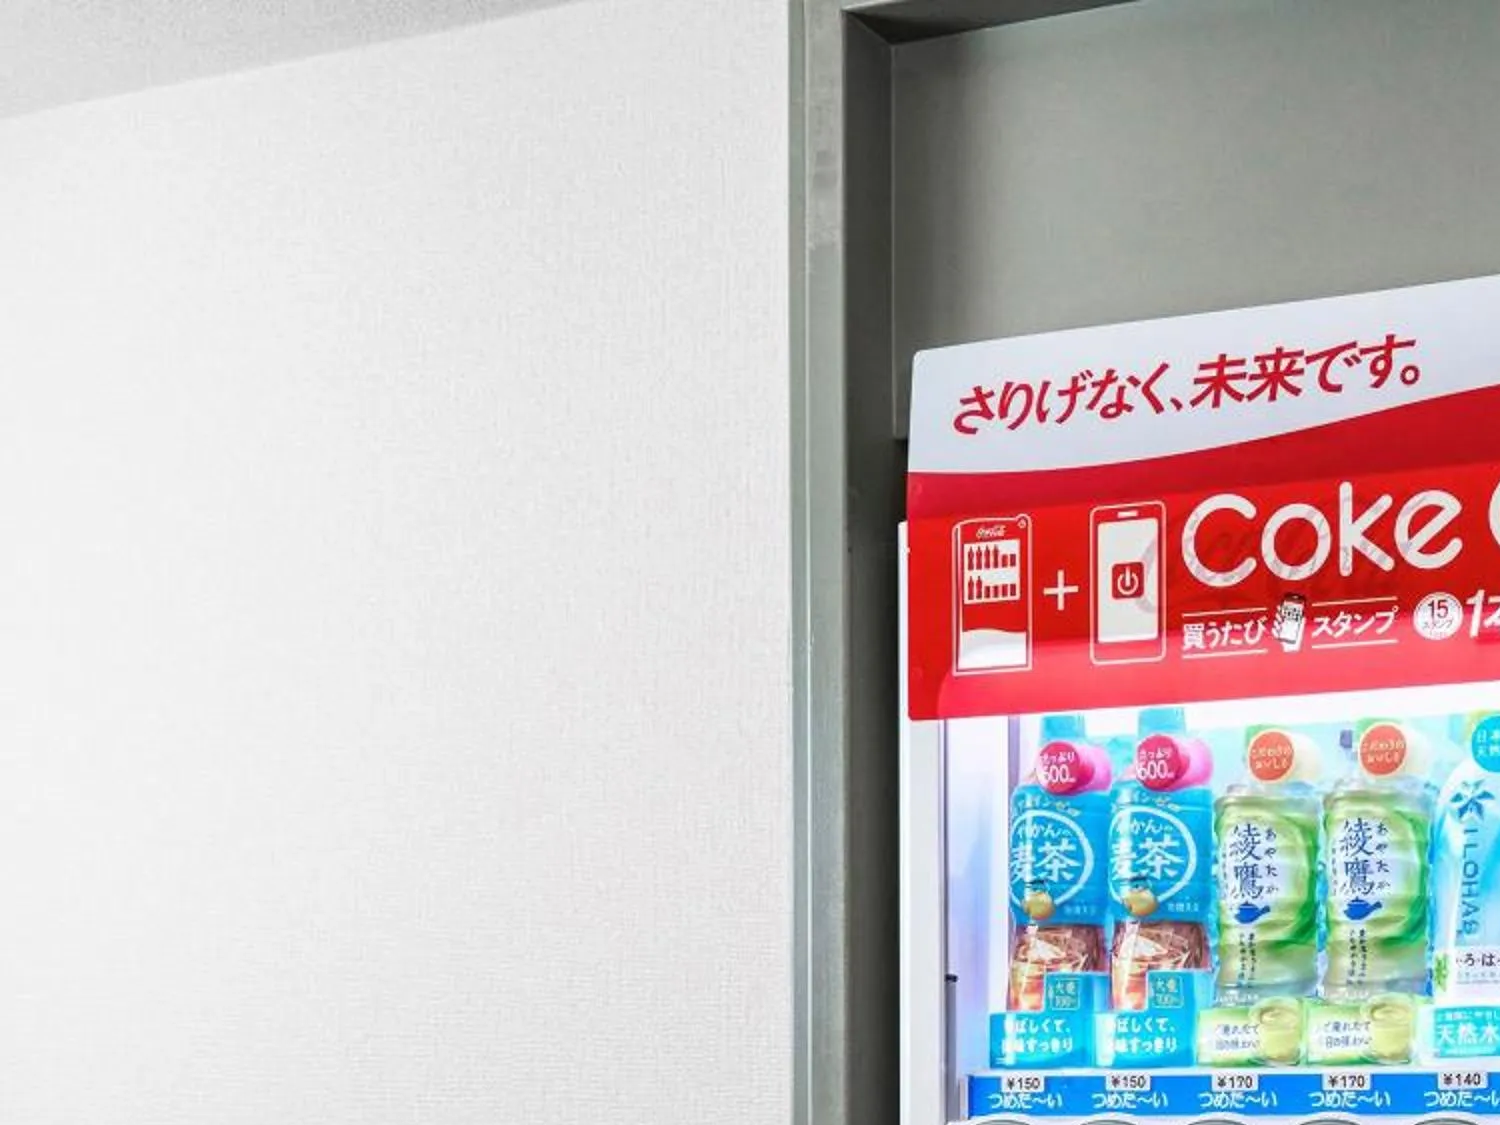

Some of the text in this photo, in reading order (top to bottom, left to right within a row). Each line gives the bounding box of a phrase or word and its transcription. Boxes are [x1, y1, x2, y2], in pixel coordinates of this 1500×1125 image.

[950, 333, 1421, 436] さりげなく、未来です。
[1181, 481, 1463, 585] Coke
[1427, 601, 1449, 618] 15
[1181, 608, 1399, 651] 買うたび スタンプ
[1005, 1017, 1071, 1033] ばしくて、
[1006, 1077, 1041, 1090] ¥150
[1111, 1075, 1147, 1088] ¥150
[1217, 1075, 1253, 1089] ¥170
[1327, 1075, 1365, 1088] ¥170
[1443, 1073, 1482, 1086] ¥140
